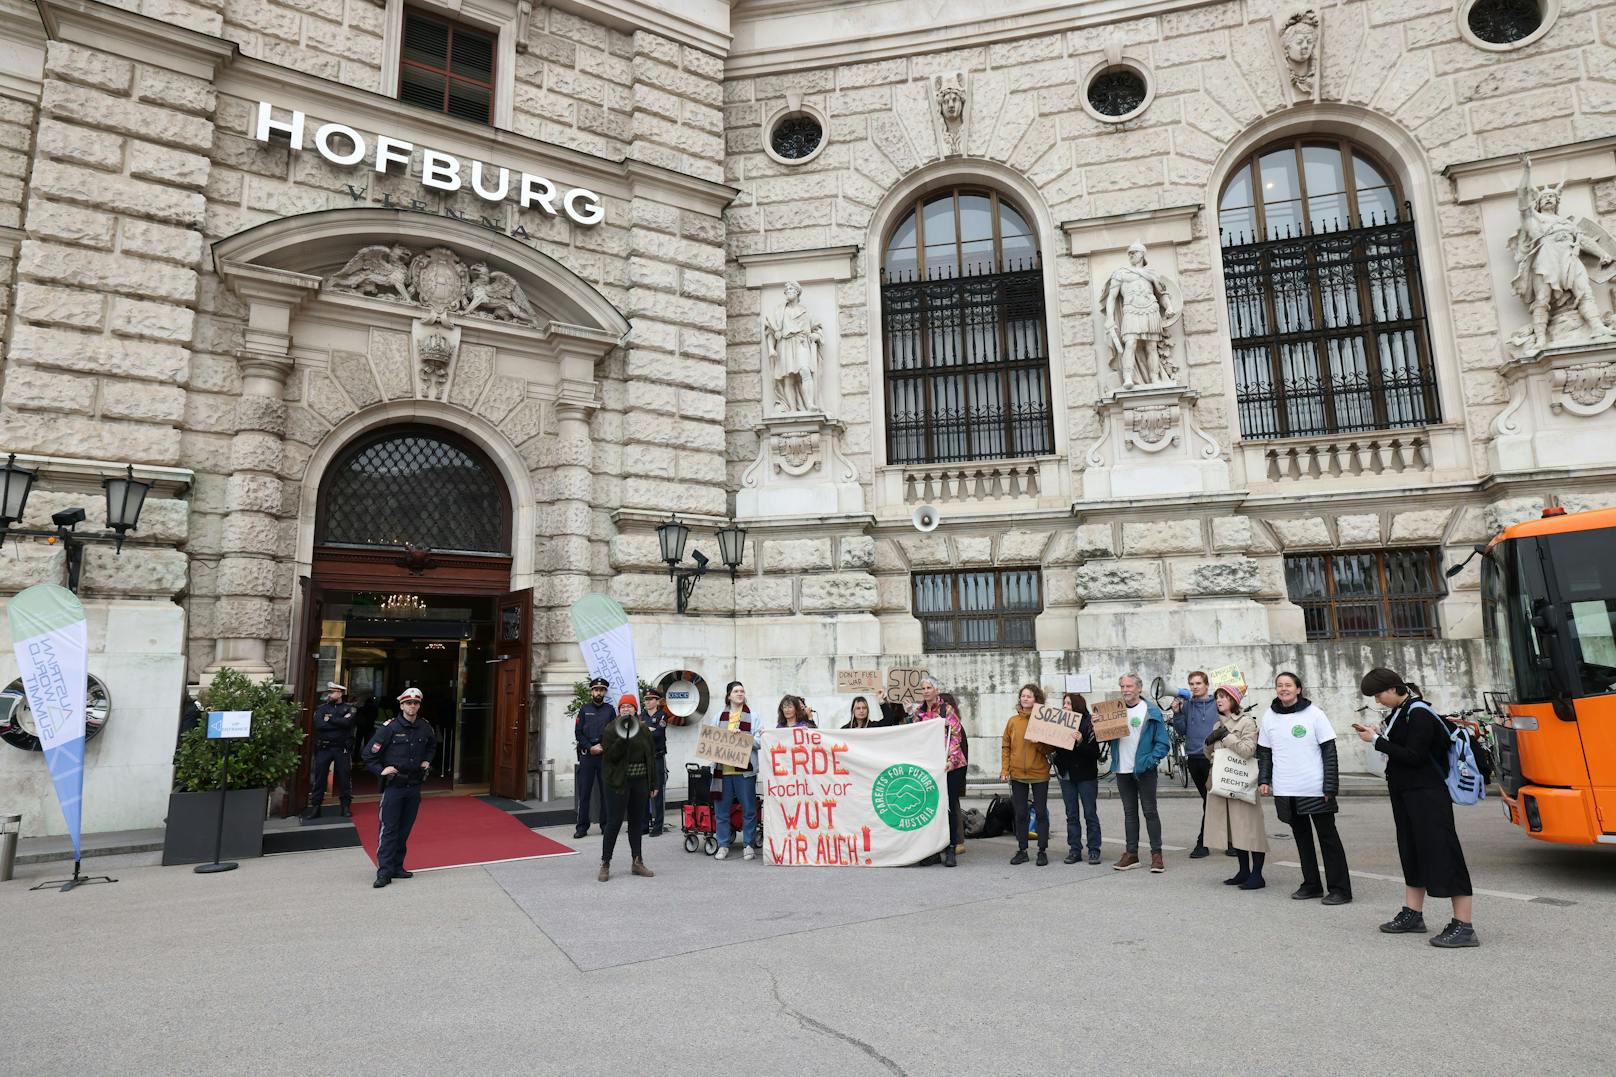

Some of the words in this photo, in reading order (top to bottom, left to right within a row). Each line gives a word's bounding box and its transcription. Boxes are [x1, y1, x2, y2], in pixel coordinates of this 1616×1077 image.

[256, 101, 605, 226] HOFBURG
[344, 184, 531, 240] VIENNA
[1034, 706, 1080, 729] SOZIALE
[1094, 710, 1128, 723] OLLGAS
[793, 727, 822, 745] Die
[770, 743, 849, 776] ERDE
[1227, 756, 1247, 766] OMAS
[1224, 766, 1249, 777] GEGEN
[768, 779, 813, 797] kocht
[821, 782, 853, 796] vor
[875, 776, 889, 814] PARENTS
[888, 766, 904, 778] FOR
[908, 766, 936, 792] FUTURE
[1221, 777, 1249, 788] RECHTS
[779, 800, 838, 829] WUT
[898, 807, 935, 828] AUSTRIA
